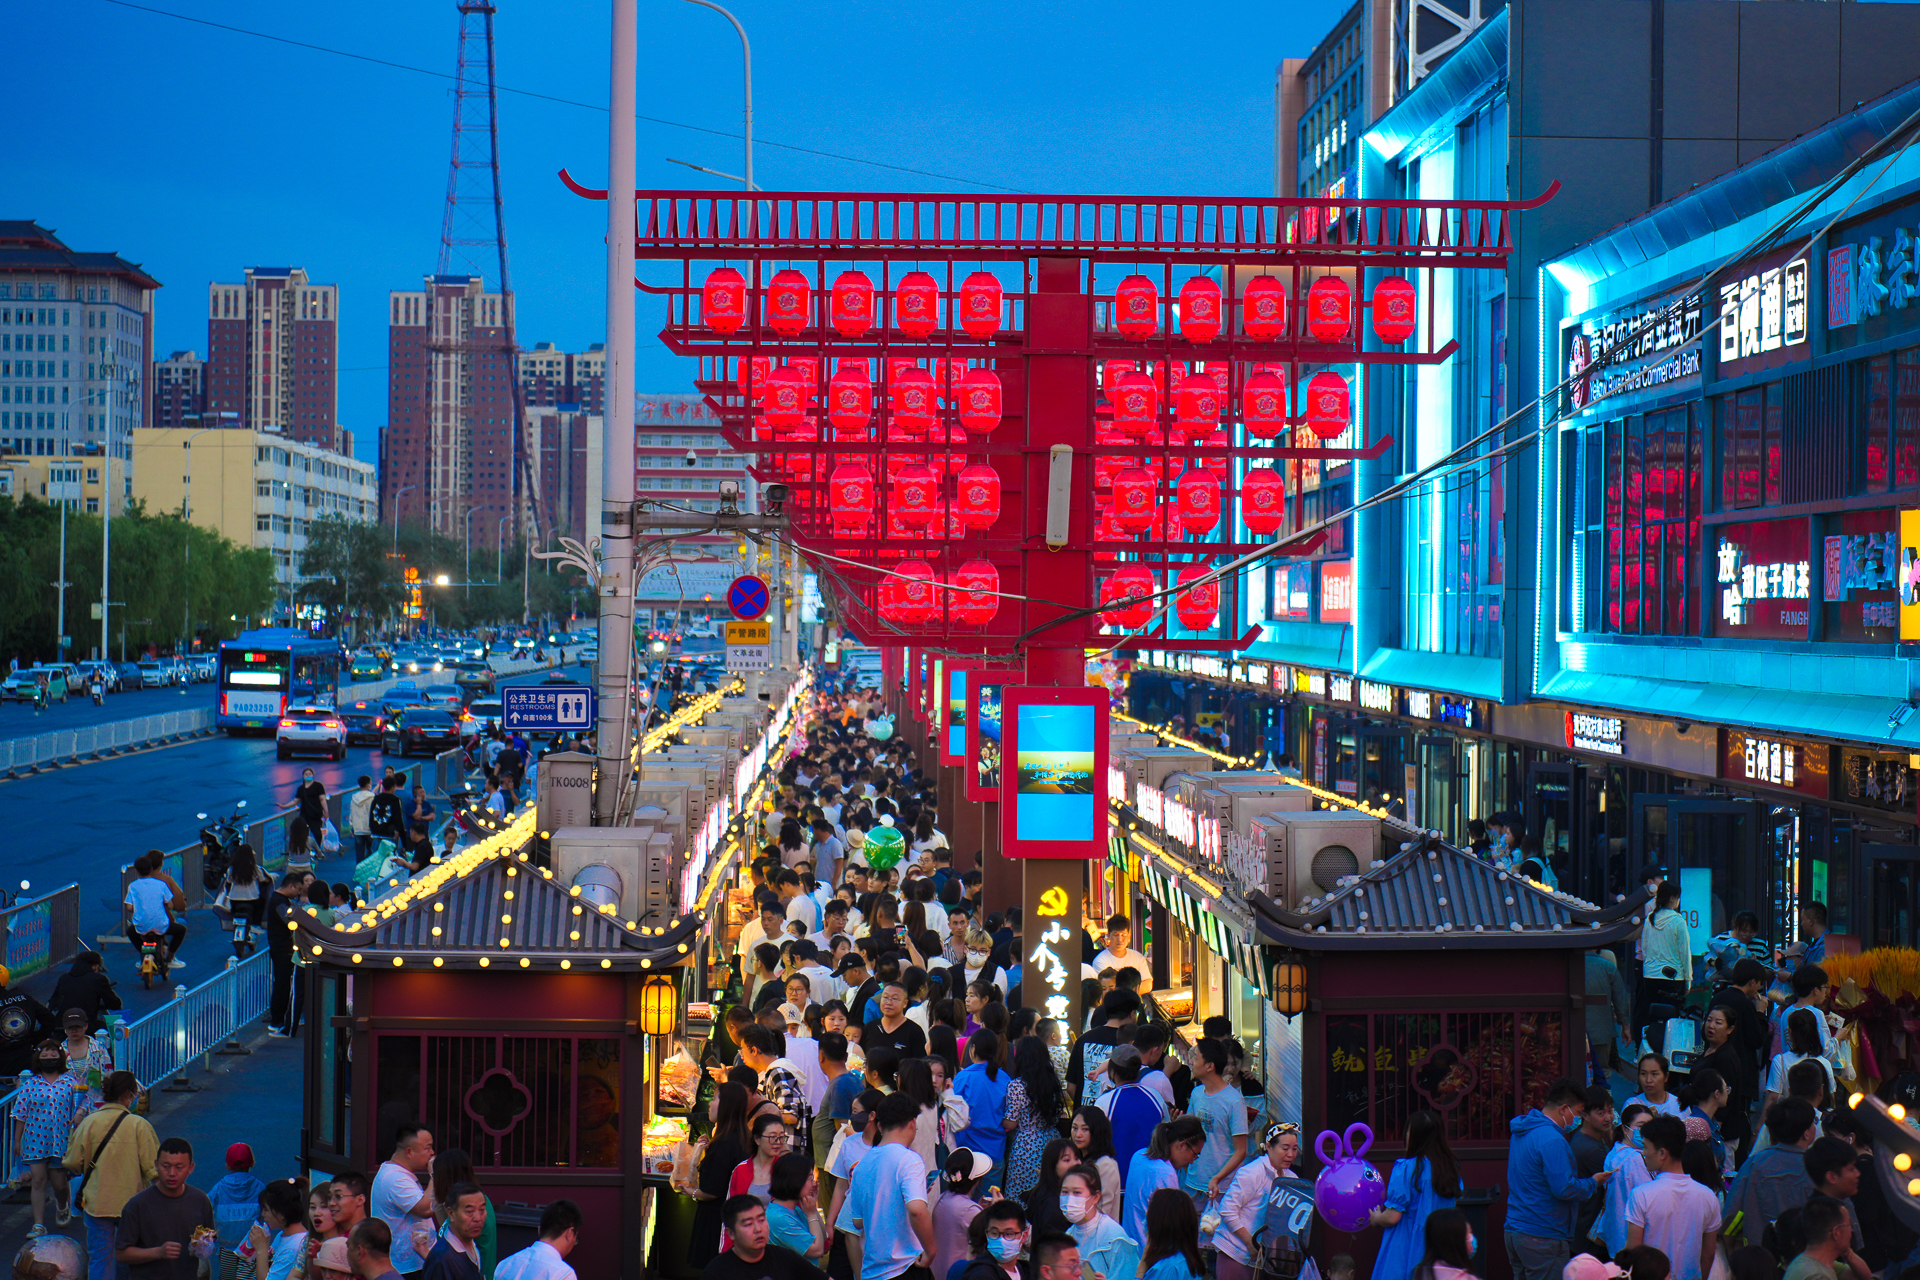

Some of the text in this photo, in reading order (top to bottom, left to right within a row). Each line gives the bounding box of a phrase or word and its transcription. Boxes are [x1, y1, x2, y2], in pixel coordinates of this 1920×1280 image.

[1720, 267, 1781, 363] 百视通
[1608, 375, 1625, 396] River
[1624, 370, 1641, 391] Rural
[1642, 354, 1681, 387] Commercial
[1682, 350, 1700, 376] Bank
[728, 628, 766, 638] 严管路段
[509, 693, 556, 704] 公共卫生间
[1745, 738, 1782, 784] 百视通
[550, 777, 589, 788] TK0008
[4, 994, 27, 1005] LOVER
